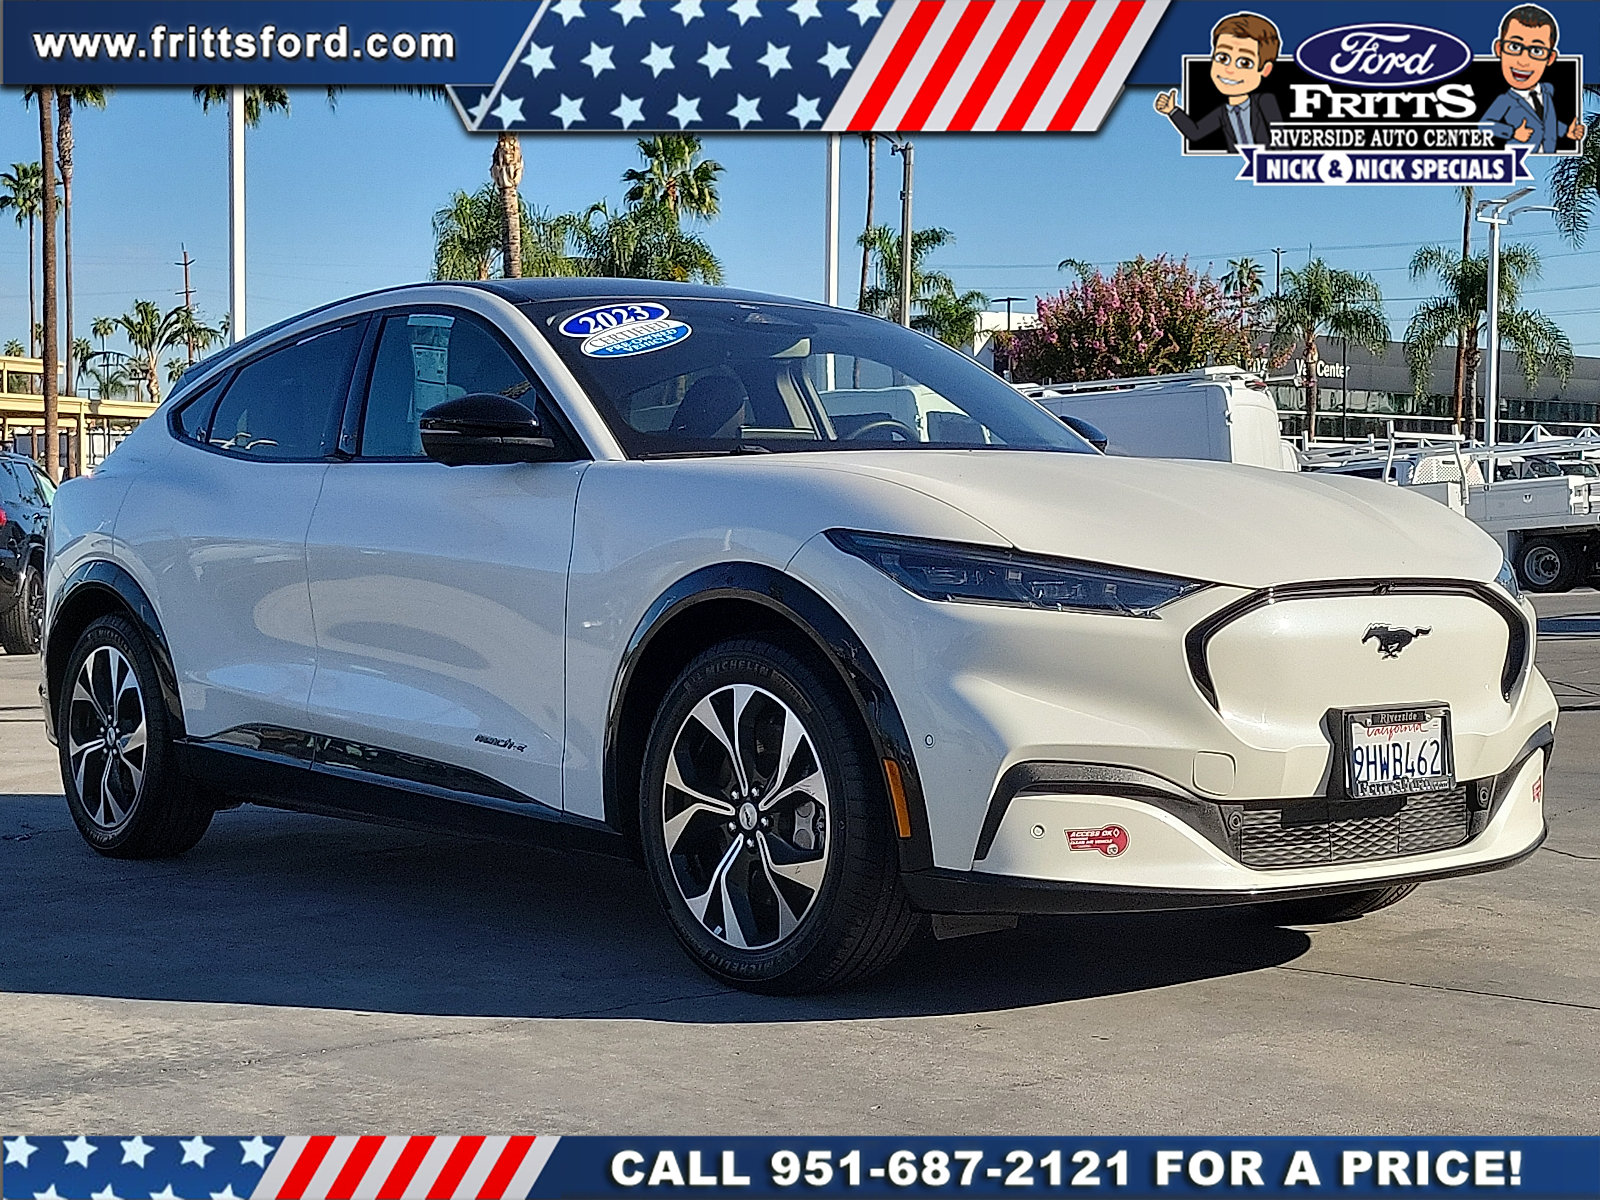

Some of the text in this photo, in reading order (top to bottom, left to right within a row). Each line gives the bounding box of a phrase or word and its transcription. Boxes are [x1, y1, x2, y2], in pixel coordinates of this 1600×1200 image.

[578, 305, 650, 334] 2023
[588, 320, 671, 348] CERTIFIED
[622, 335, 677, 353] VEHICLE
[1316, 360, 1351, 379] Center
[705, 658, 770, 677] MICHELIN
[1380, 712, 1418, 724] Riverside
[1352, 739, 1442, 783] 9HWB462
